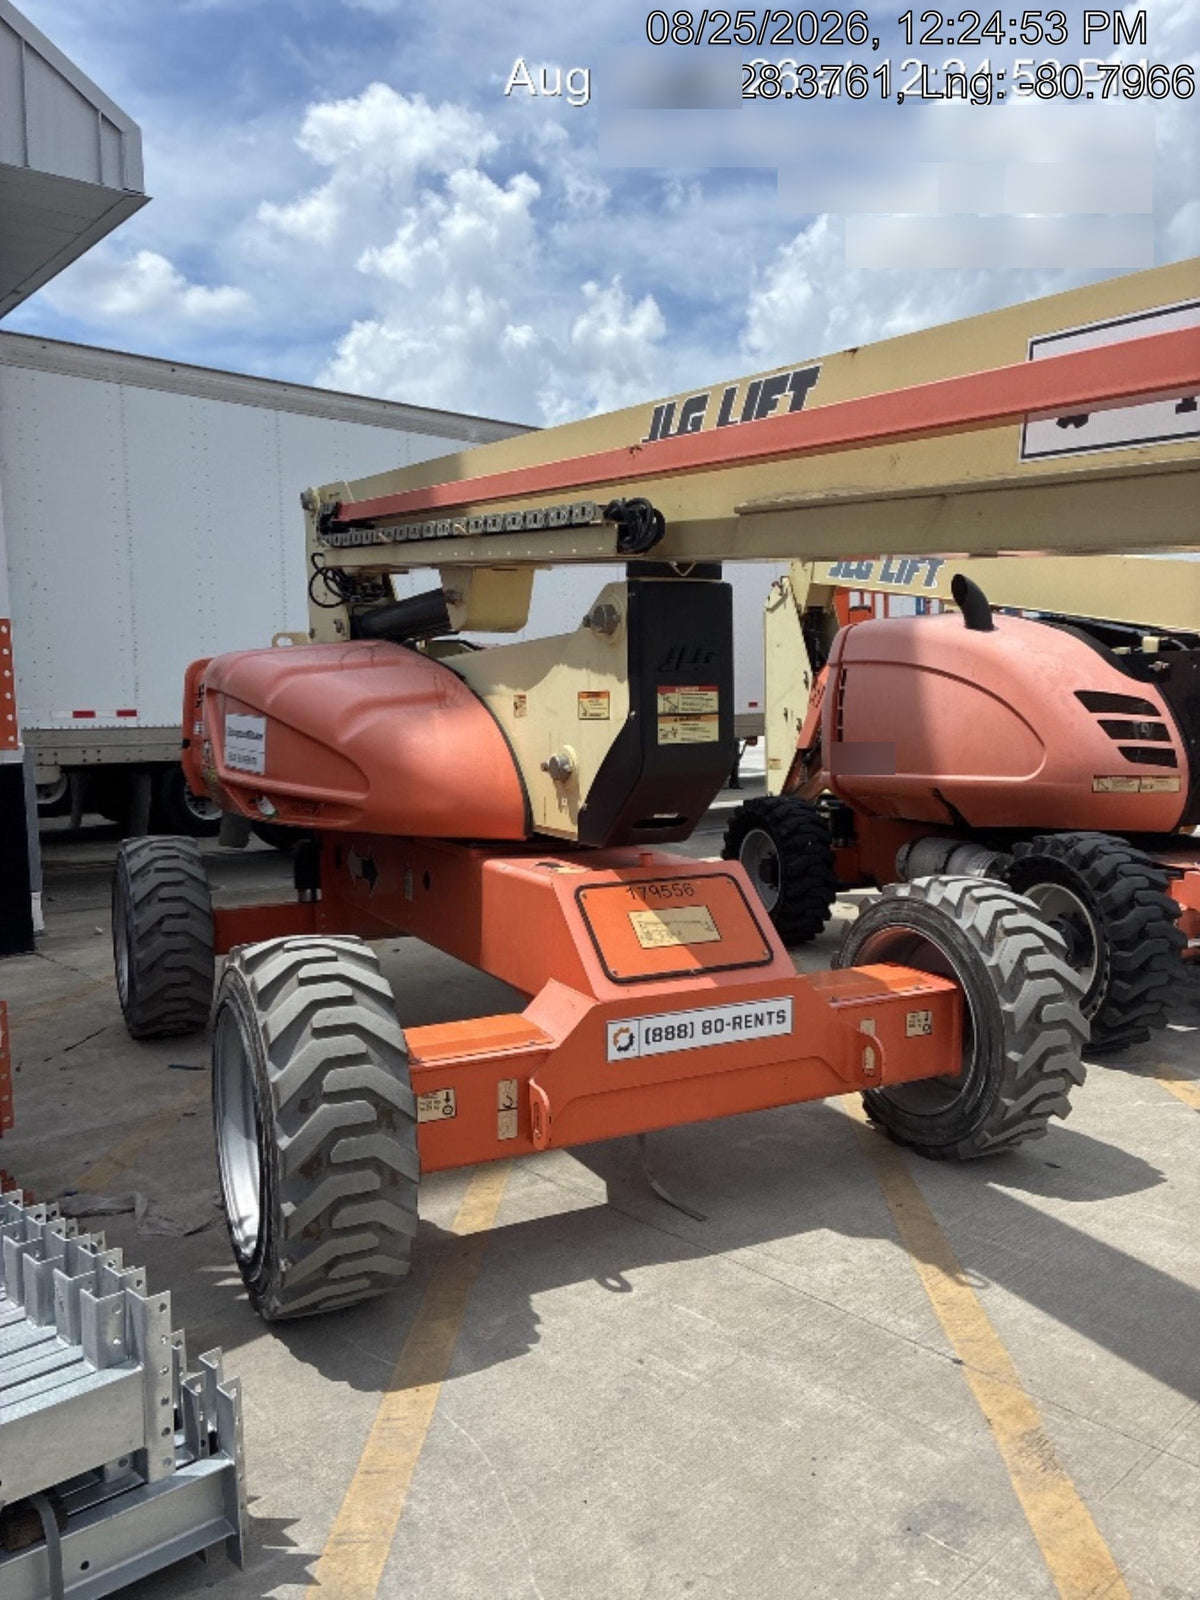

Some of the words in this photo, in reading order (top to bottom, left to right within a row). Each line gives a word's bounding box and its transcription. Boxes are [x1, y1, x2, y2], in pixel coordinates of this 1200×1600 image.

[640, 391, 711, 445] JLG
[715, 363, 823, 428] LIFT
[877, 559, 945, 589] LIFT
[625, 882, 695, 900] 179556
[644, 1021, 694, 1046] (888)
[701, 1009, 787, 1036] 80-RENTS
